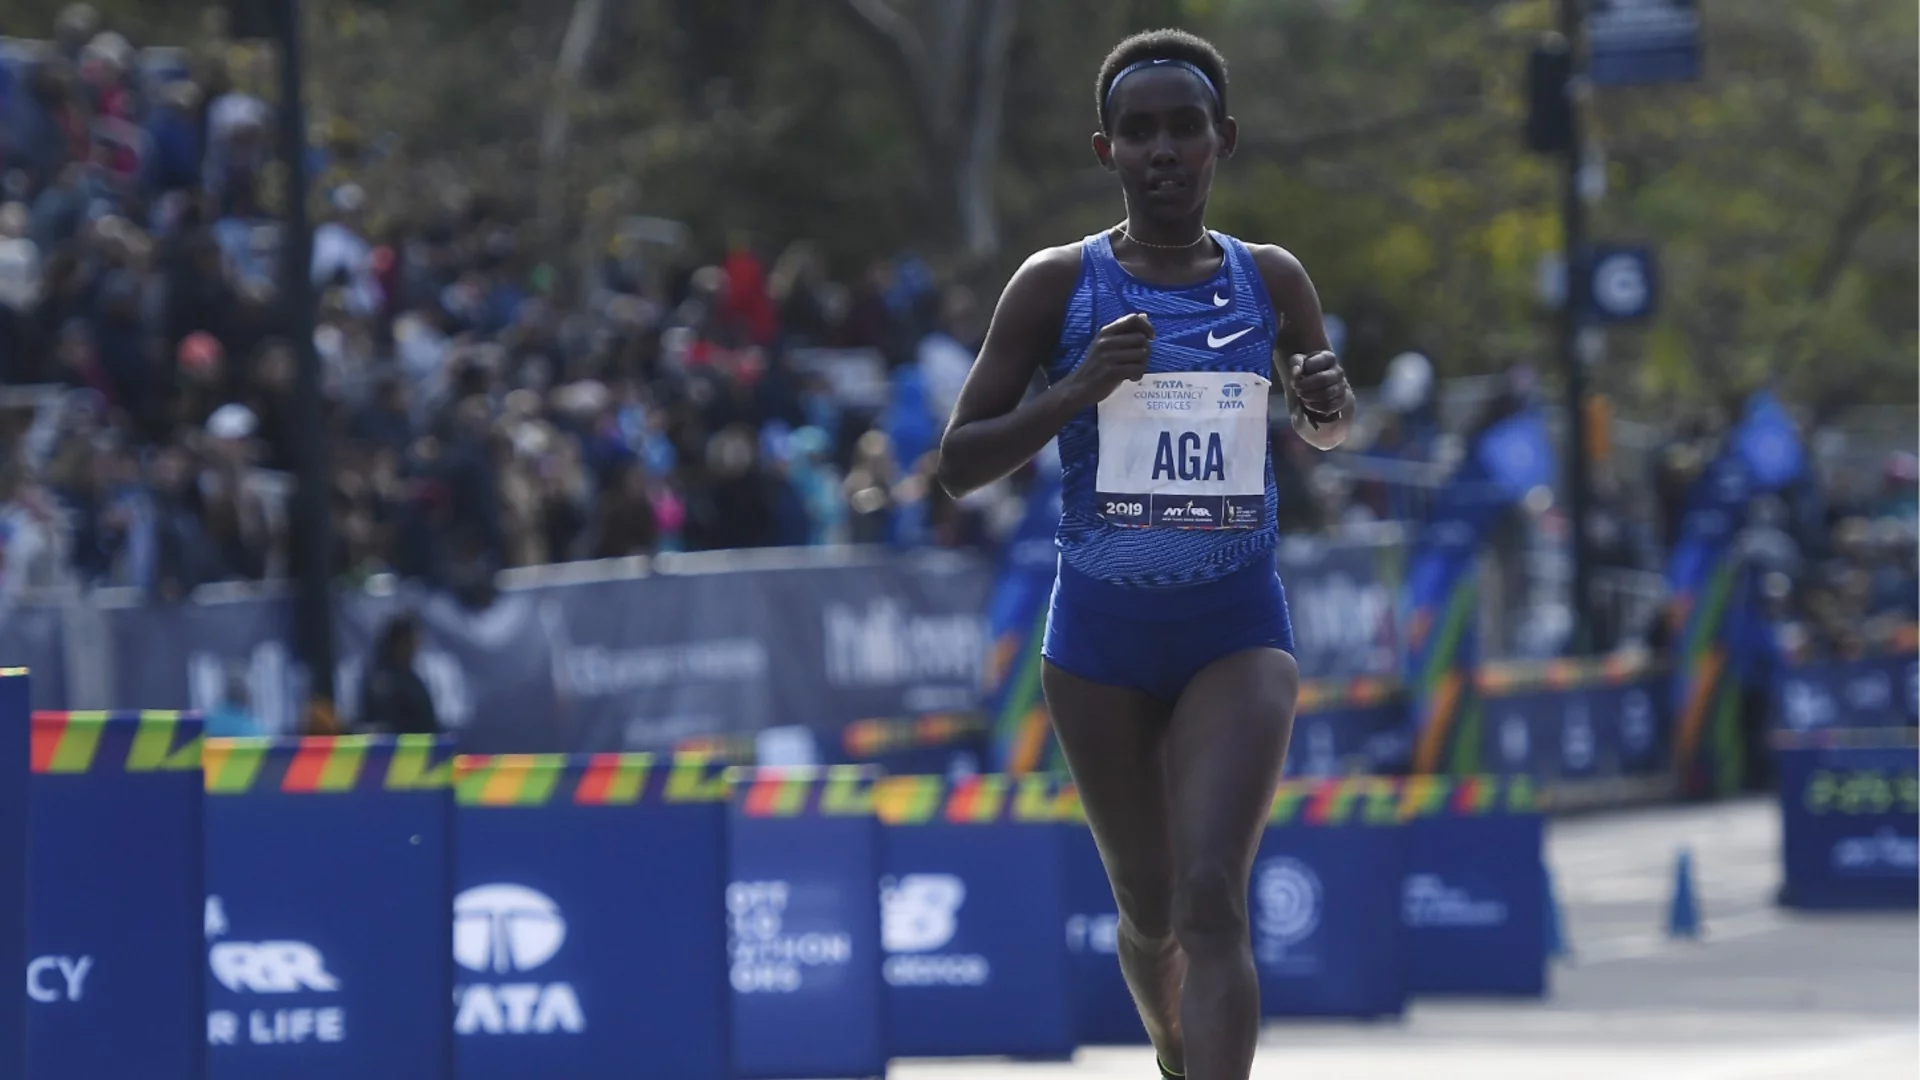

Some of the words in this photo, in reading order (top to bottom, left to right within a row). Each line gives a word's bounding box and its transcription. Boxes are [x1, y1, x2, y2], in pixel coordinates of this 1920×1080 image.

[1155, 380, 1184, 389] TATA
[1134, 390, 1204, 400] CONSULTANCY
[1146, 401, 1192, 410] SERVICES
[1216, 400, 1245, 409] TATA
[1151, 431, 1225, 481] AGA
[1106, 502, 1143, 516] 2019
[27, 956, 93, 1002] CY
[207, 1010, 240, 1045] R
[250, 1006, 346, 1044] LIFE
